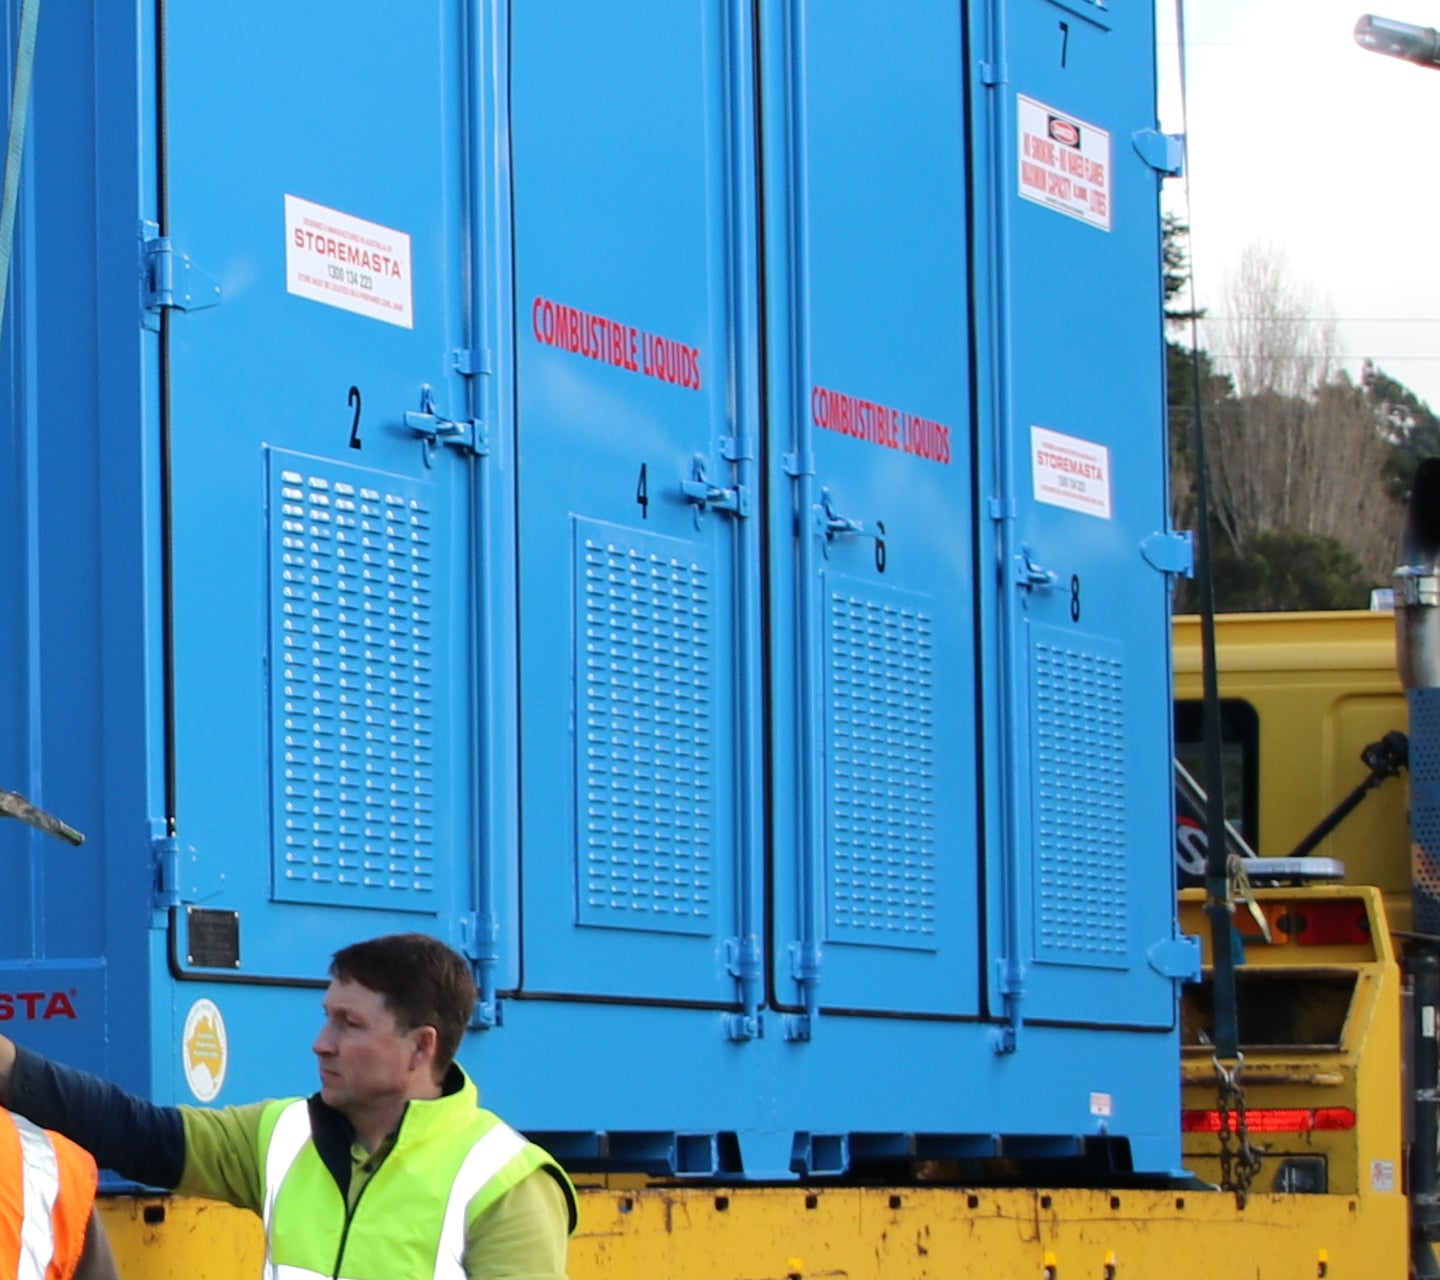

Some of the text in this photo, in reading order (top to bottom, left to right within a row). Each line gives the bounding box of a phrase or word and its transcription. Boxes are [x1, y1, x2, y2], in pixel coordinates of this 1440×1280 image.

[1059, 21, 1069, 68] 7
[294, 228, 401, 279] STOREMASTA
[533, 296, 701, 391] COMBUSTIBLE LIQUIDS
[348, 385, 362, 450] 2
[812, 386, 951, 465] COMBUSTIBLE LIQUIDS
[636, 462, 648, 519] 4
[1037, 450, 1103, 480] STOREMASTA
[1070, 574, 1080, 622] 8
